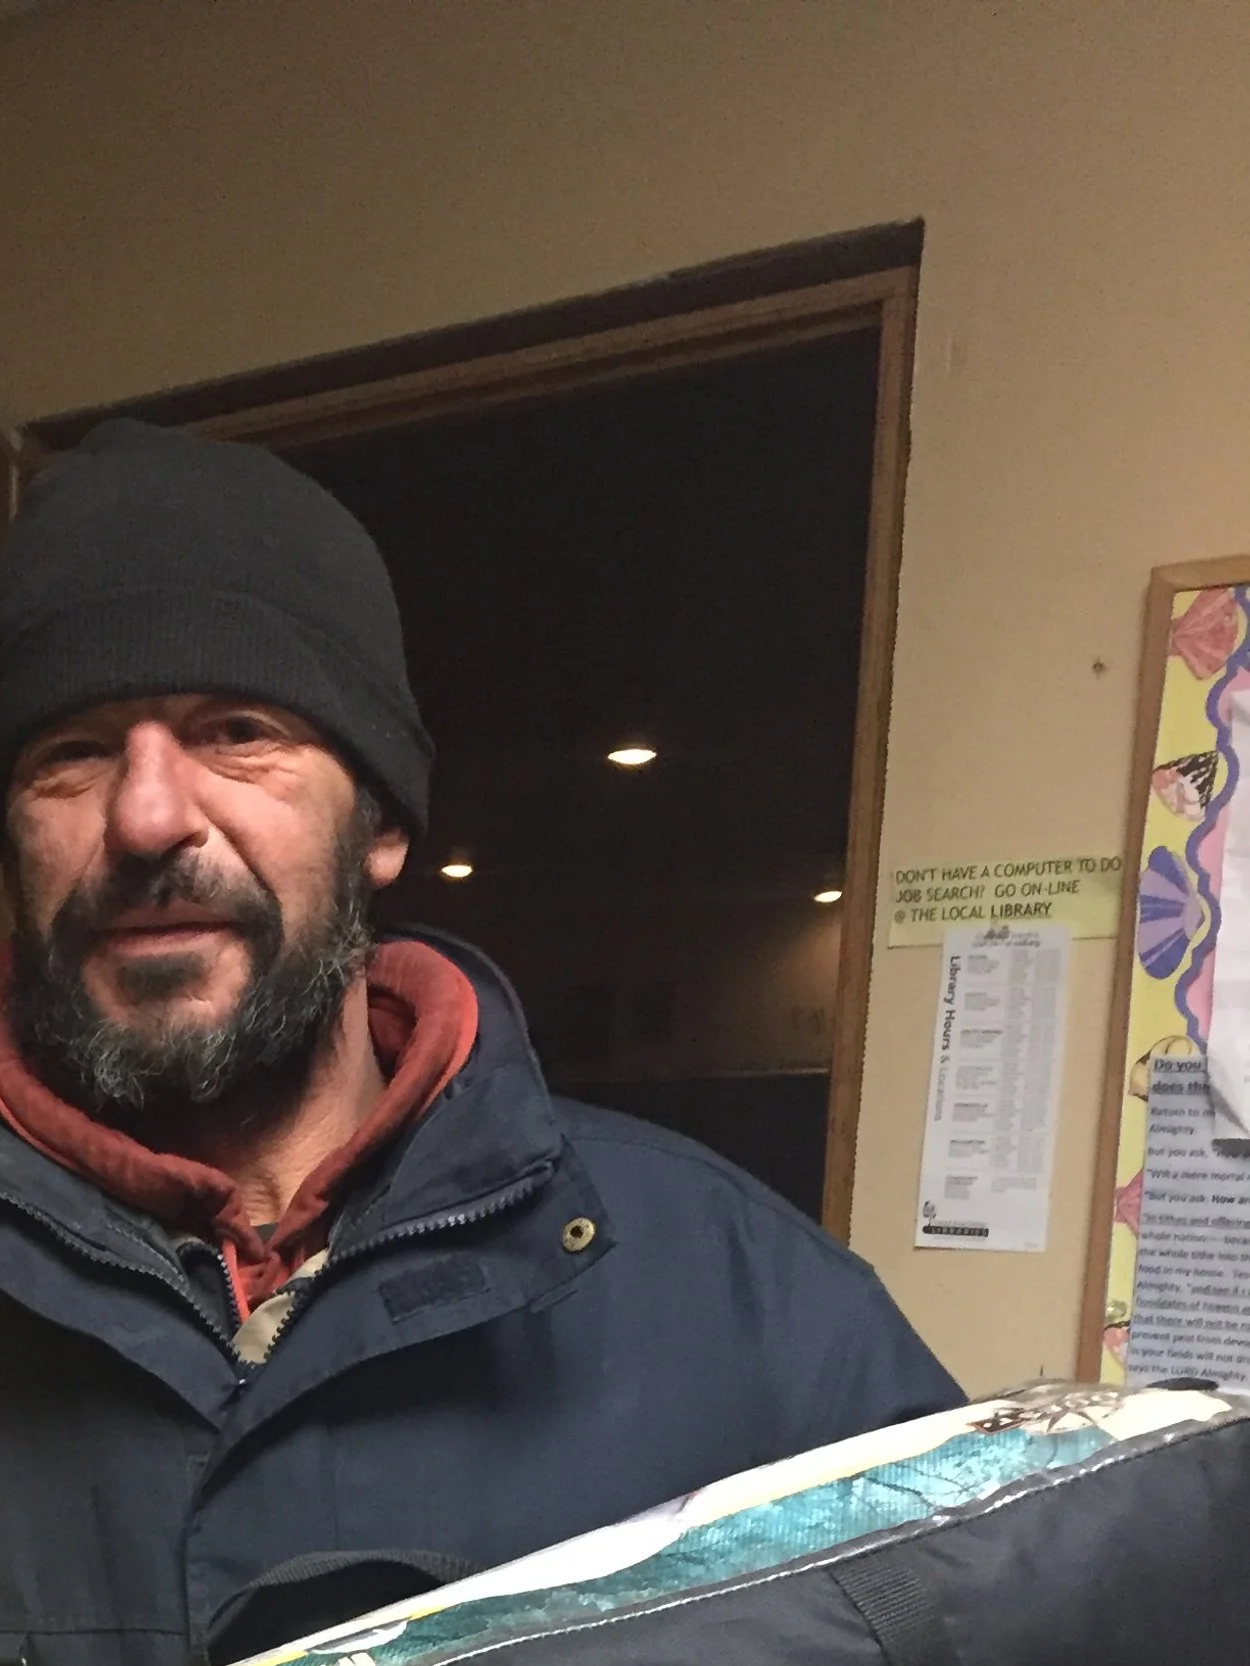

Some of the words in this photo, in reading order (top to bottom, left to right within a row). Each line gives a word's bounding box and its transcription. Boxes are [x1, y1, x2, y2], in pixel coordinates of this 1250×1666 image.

[941, 865, 978, 881] HAVE
[980, 865, 990, 878] A
[993, 859, 1072, 878] COMPUTER
[1077, 857, 1096, 873] TO
[1100, 855, 1122, 873] DO
[895, 888, 922, 903] JOB
[926, 885, 985, 902] SEARCH?
[994, 883, 1016, 898] GO
[911, 907, 938, 922] THE
[941, 905, 986, 921] LOCAL
[990, 902, 1052, 919] LIBRARY
[943, 955, 961, 1005] Library
[941, 1009, 956, 1051] Hours
[1154, 1059, 1173, 1071] Do
[1176, 1061, 1202, 1073] you
